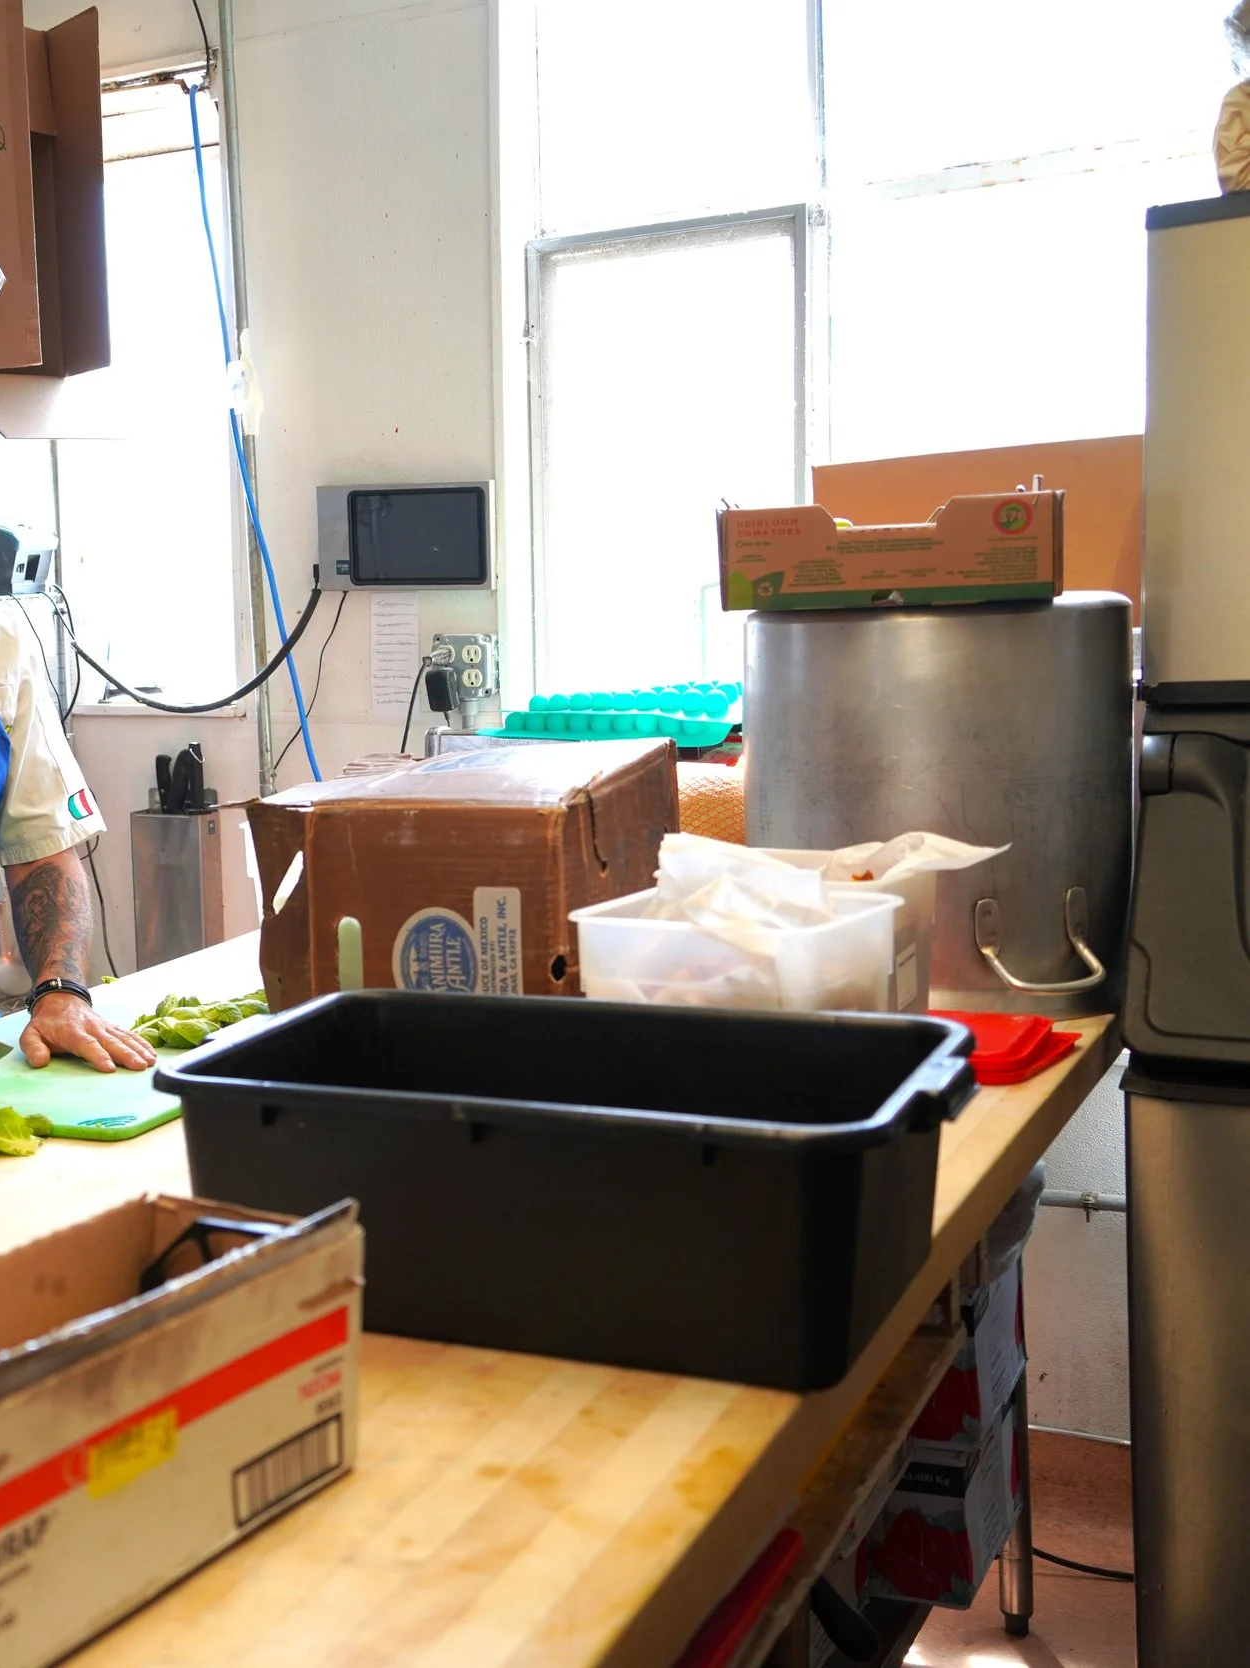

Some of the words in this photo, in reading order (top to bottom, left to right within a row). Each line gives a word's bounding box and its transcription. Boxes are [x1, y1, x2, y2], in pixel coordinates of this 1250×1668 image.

[735, 518, 800, 528] HEIRLOOM
[737, 528, 802, 538] TOMATOES
[496, 896, 507, 919] INC.
[479, 916, 489, 955] MEXICO
[497, 923, 508, 961] ANTLE,
